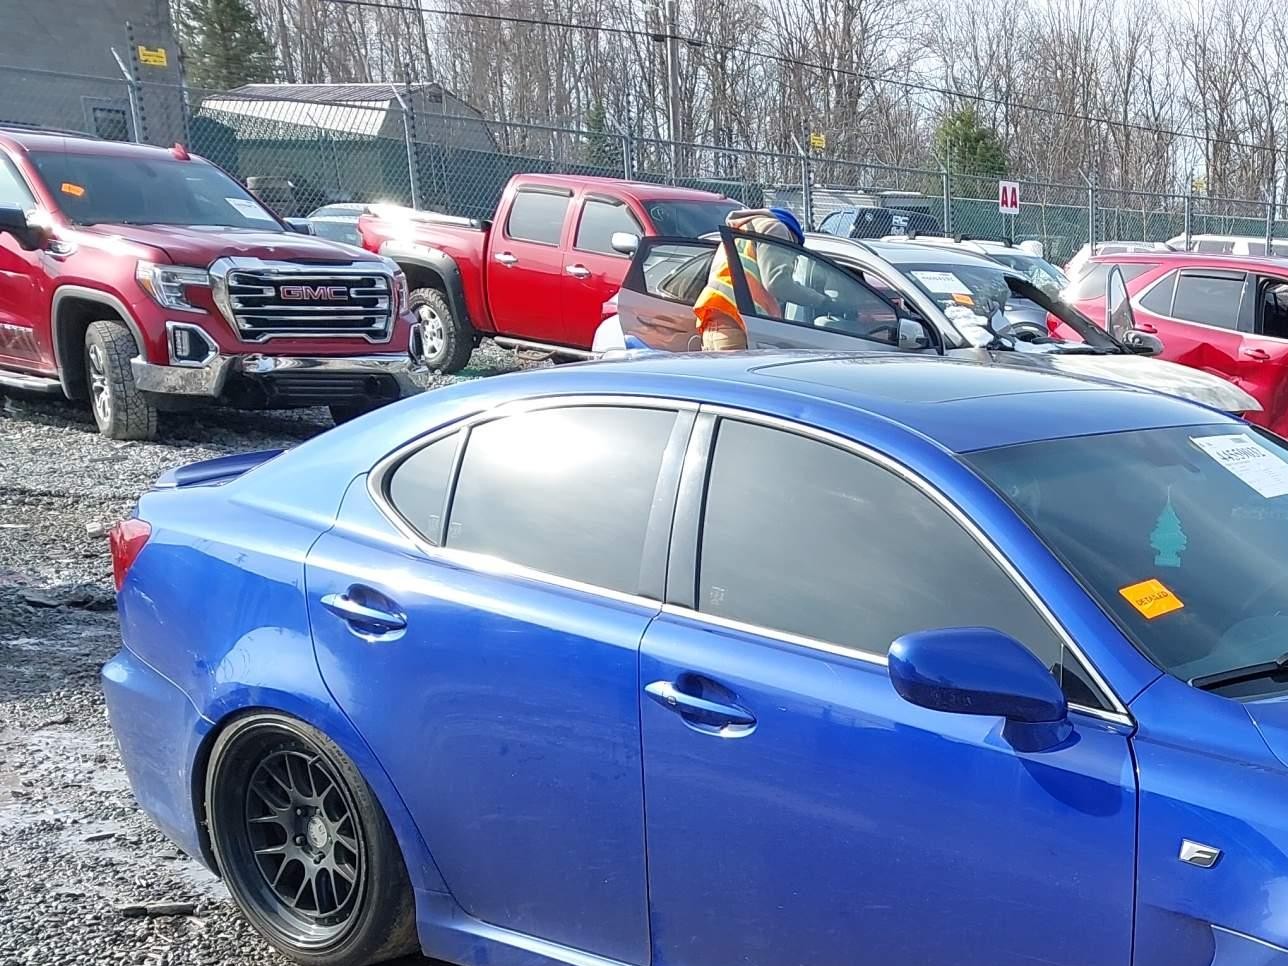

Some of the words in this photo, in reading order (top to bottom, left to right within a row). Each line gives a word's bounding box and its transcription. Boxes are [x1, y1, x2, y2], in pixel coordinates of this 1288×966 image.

[1000, 185, 1018, 208] AA
[280, 285, 348, 300] GMC
[1135, 590, 1169, 606] DETAILED
